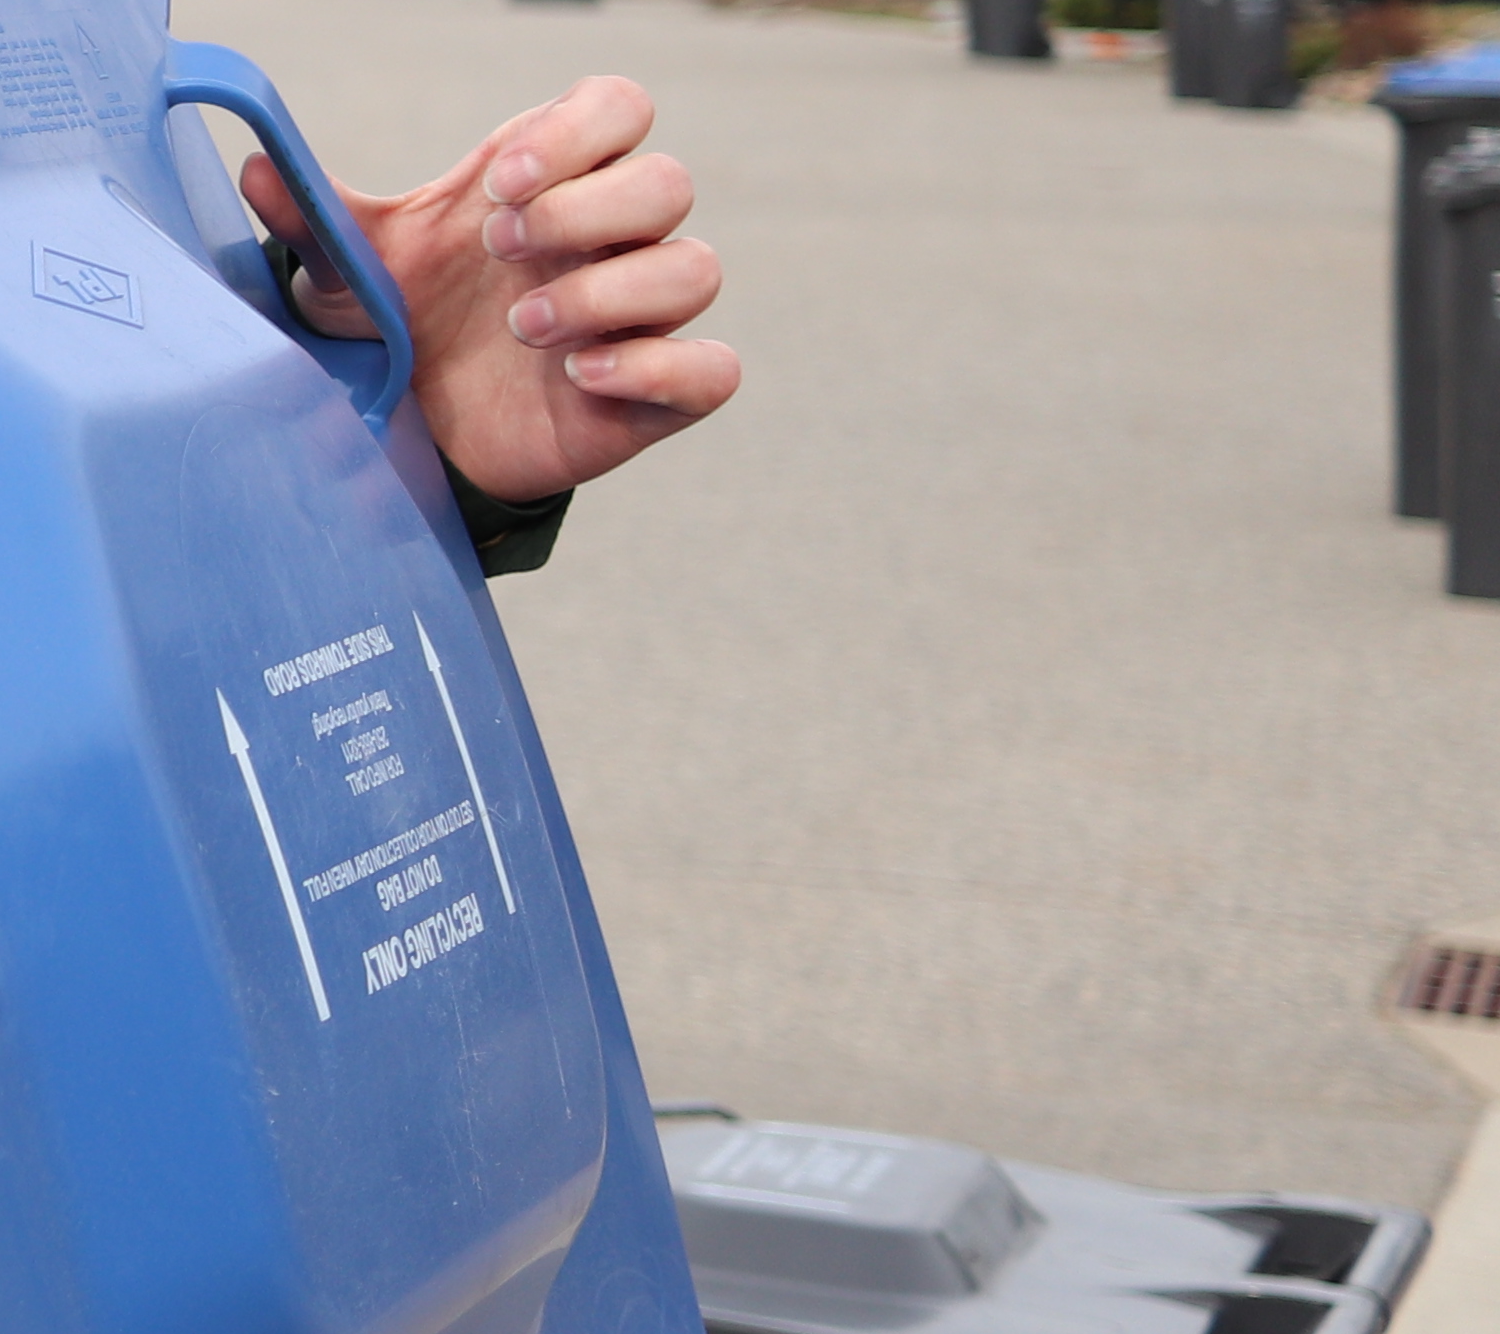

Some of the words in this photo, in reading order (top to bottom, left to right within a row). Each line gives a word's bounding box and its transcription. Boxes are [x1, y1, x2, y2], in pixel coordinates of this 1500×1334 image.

[341, 631, 373, 665] SIDE
[364, 623, 394, 656] THIS
[263, 660, 302, 696] ROAD
[295, 641, 352, 684] TOWARDS
[344, 702, 360, 724] for
[354, 692, 370, 718] you
[366, 689, 392, 716] Thank
[364, 759, 389, 787] INFO
[382, 752, 405, 779] FOR
[344, 768, 371, 796] CALL
[433, 812, 450, 837] ON
[444, 806, 463, 832] OUT
[457, 798, 475, 825] SET
[414, 818, 441, 847] YOUR
[371, 829, 421, 869] COLLECTION
[325, 859, 358, 892] WHEN
[353, 851, 374, 880] DAY
[402, 861, 428, 900] NOT
[423, 854, 443, 887] DO
[302, 871, 331, 902] FULL
[376, 873, 406, 911] BAG
[404, 892, 484, 969] RECYCLING
[362, 935, 408, 995] ONLY
